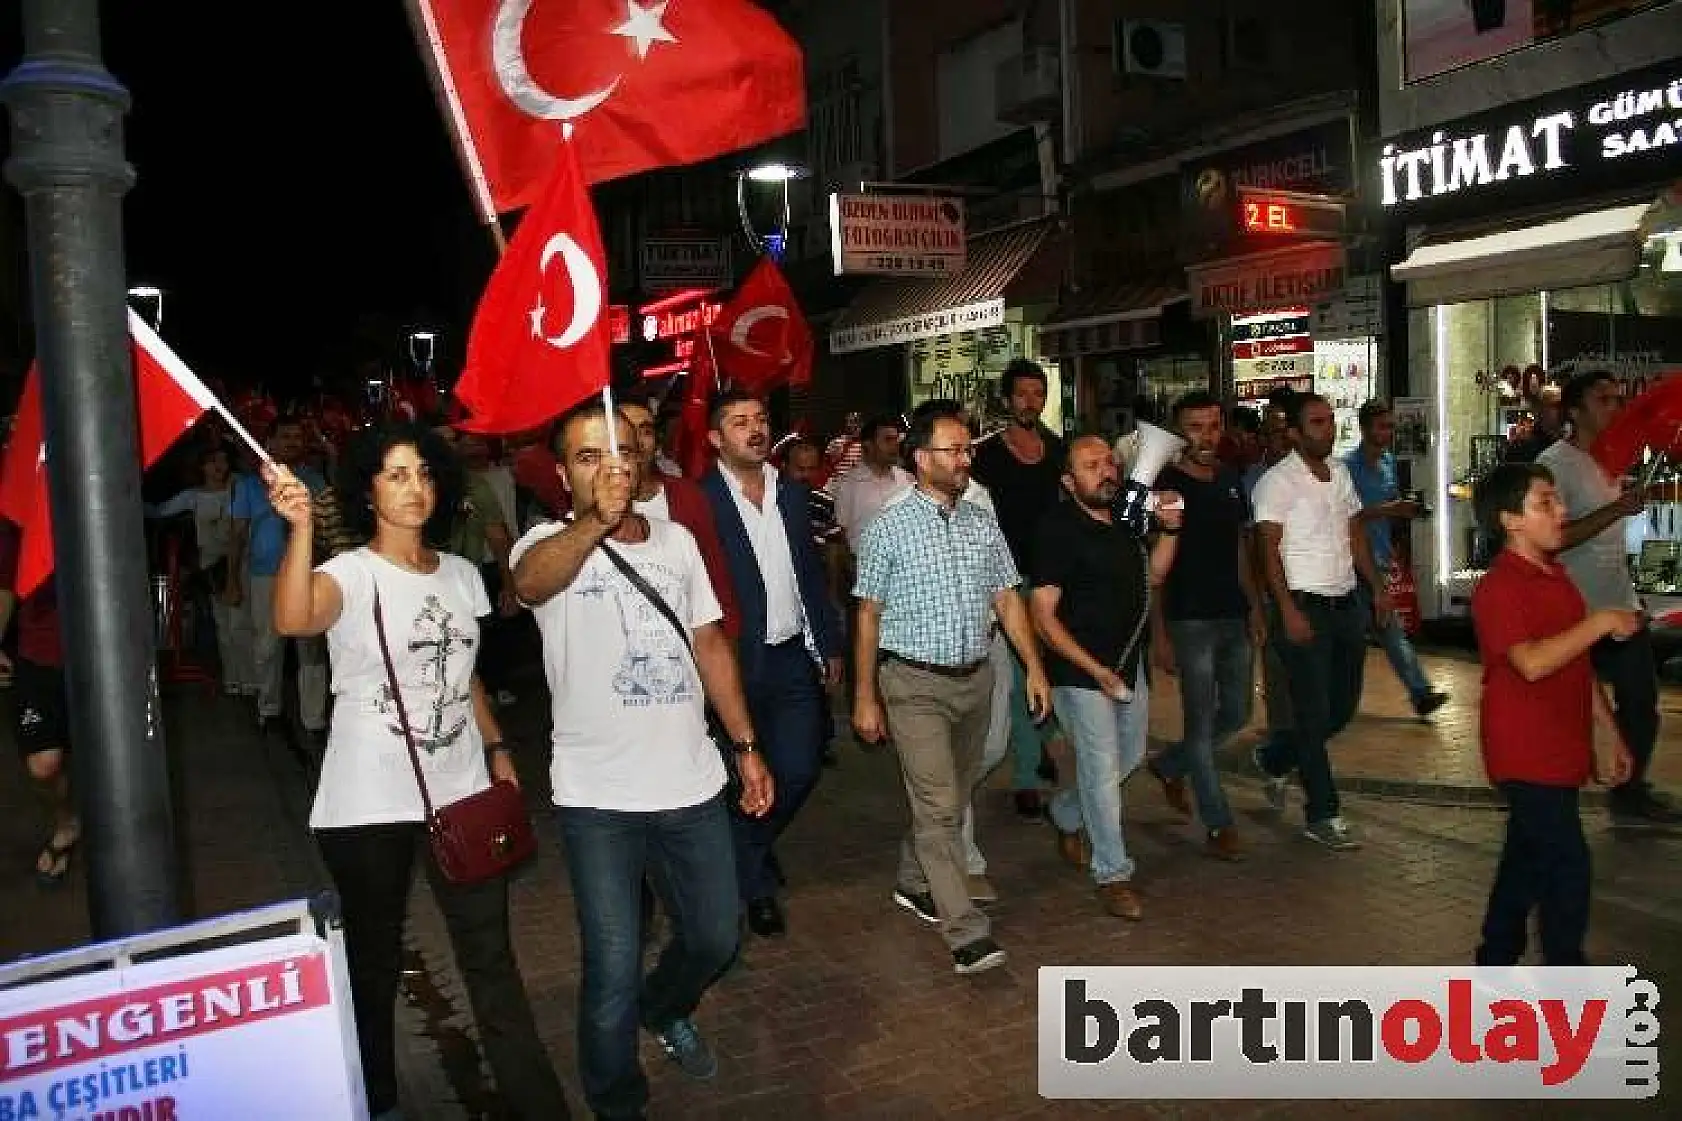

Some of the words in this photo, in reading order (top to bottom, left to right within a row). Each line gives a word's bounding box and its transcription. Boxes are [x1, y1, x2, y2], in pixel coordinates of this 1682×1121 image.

[1381, 111, 1574, 205] İTİMAT
[1245, 203, 1262, 227] 2
[1267, 204, 1294, 229] EL
[4, 961, 303, 1069] ENGENLİ
[48, 1045, 189, 1117] ÇEŞİTLERİ
